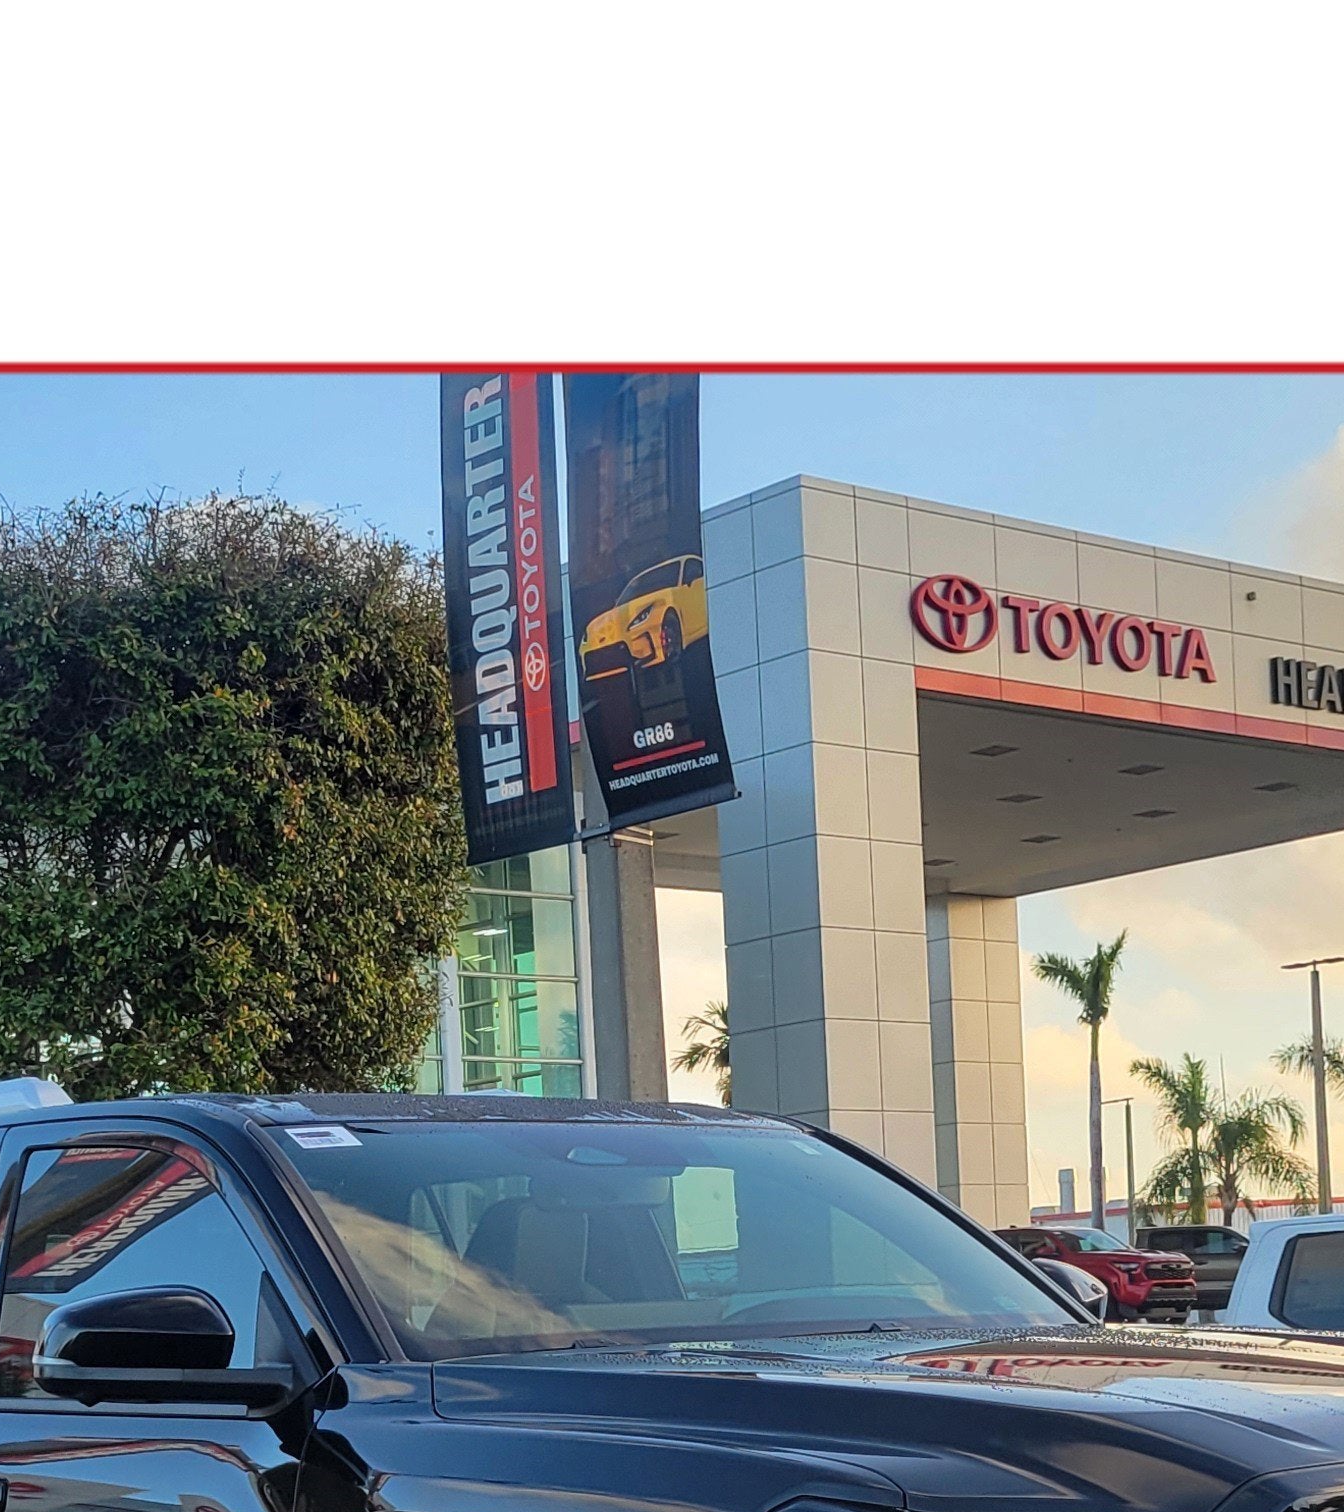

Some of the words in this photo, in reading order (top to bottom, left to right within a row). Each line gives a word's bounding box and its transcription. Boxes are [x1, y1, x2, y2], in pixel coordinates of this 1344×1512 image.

[463, 373, 524, 805] HEADQUARTER
[518, 474, 542, 639] TOYOTA
[1002, 596, 1217, 682] TOYOTA
[608, 752, 719, 791] HEADQUARTERTOYOTA.COM
[633, 722, 674, 749] GR86
